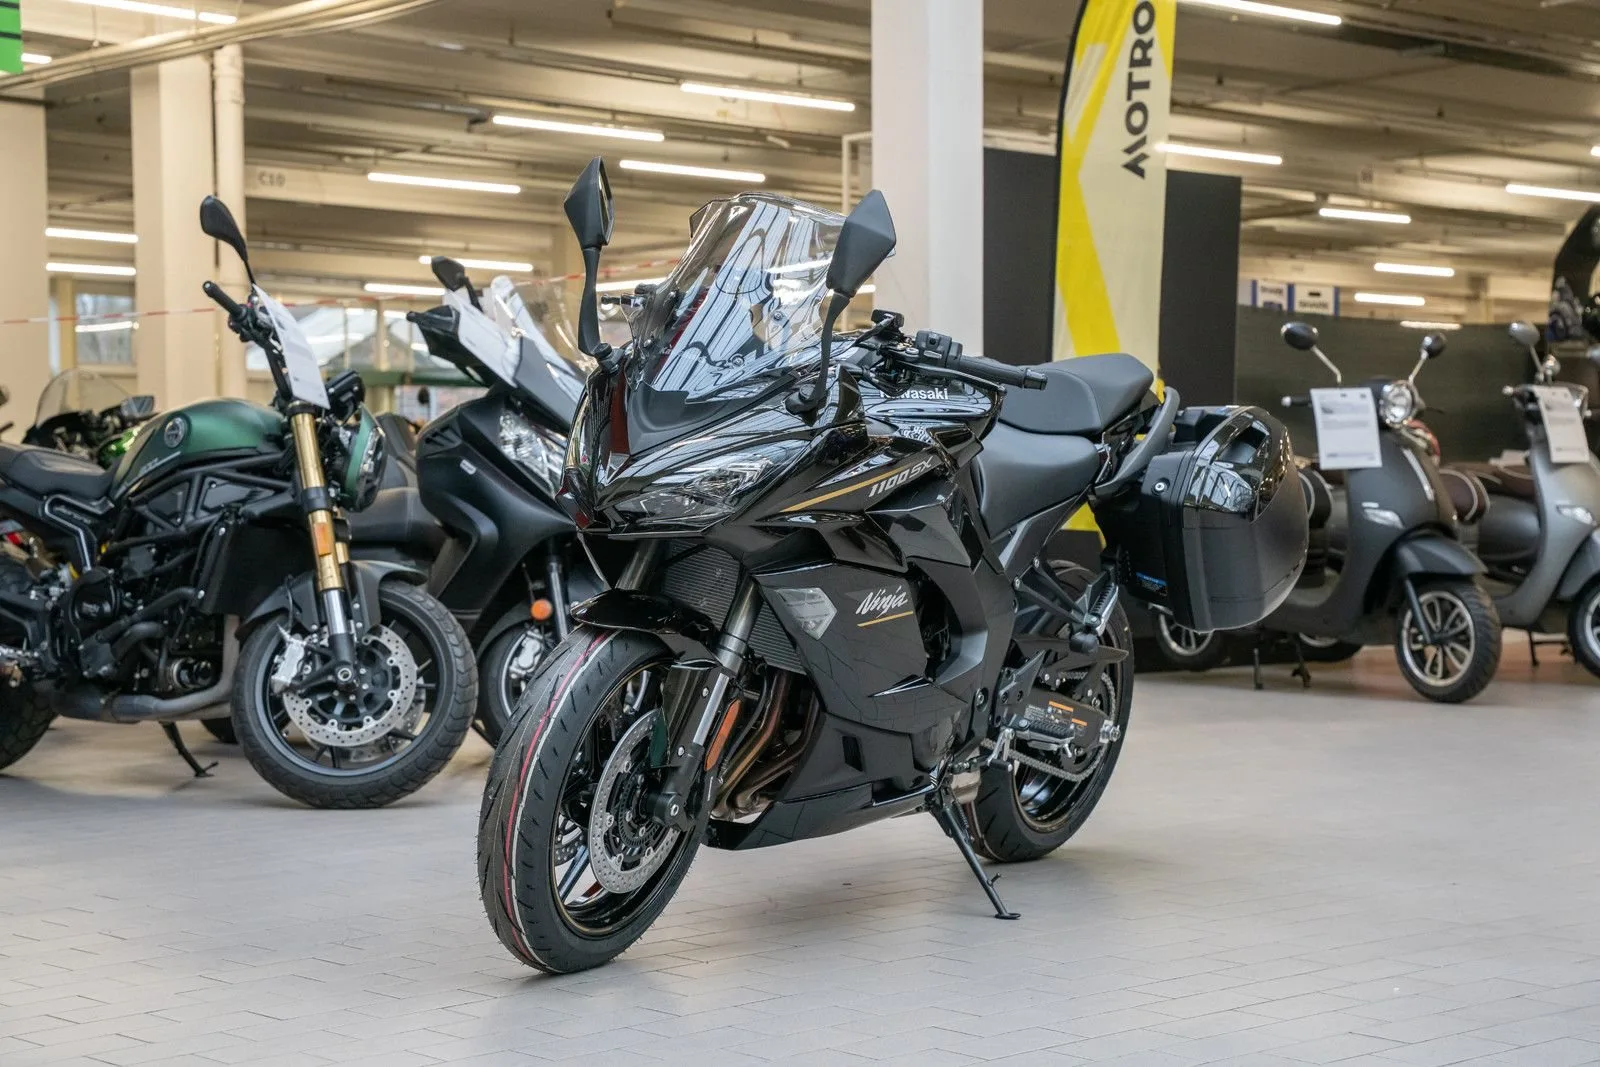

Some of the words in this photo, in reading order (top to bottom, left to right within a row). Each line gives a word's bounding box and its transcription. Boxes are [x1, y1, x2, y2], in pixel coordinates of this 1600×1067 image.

[1121, 0, 1156, 180] MOTRO
[880, 387, 949, 400] wasaki
[855, 585, 909, 618] Ninja
